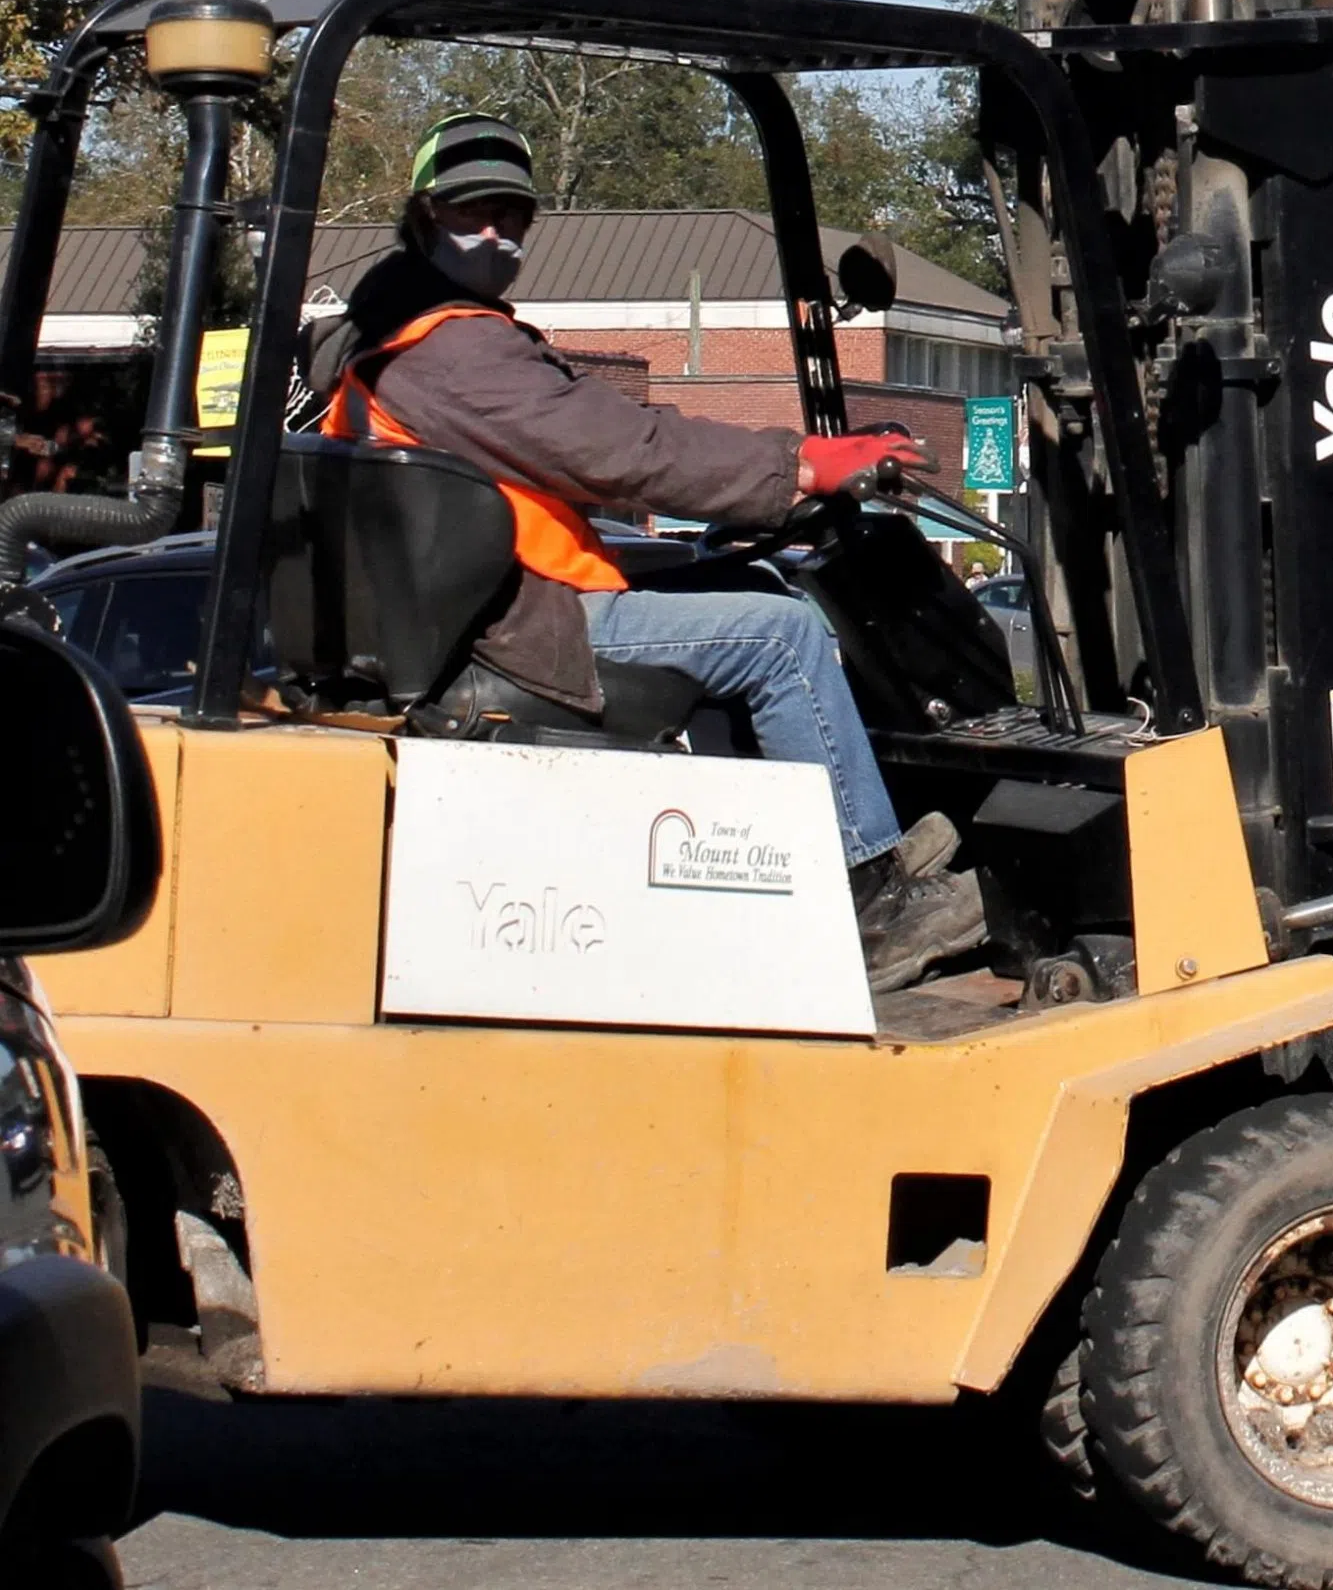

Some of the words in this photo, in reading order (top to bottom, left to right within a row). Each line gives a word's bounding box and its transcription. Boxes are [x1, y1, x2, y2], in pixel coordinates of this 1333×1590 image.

[711, 822, 736, 837] Town
[740, 823, 753, 840] of
[679, 840, 740, 864] Mount
[747, 844, 791, 868] Olive
[662, 863, 676, 879] We
[678, 863, 702, 880] Value
[705, 866, 750, 883] Hometown
[752, 868, 792, 884] Tradition
[456, 880, 607, 955] Yale
